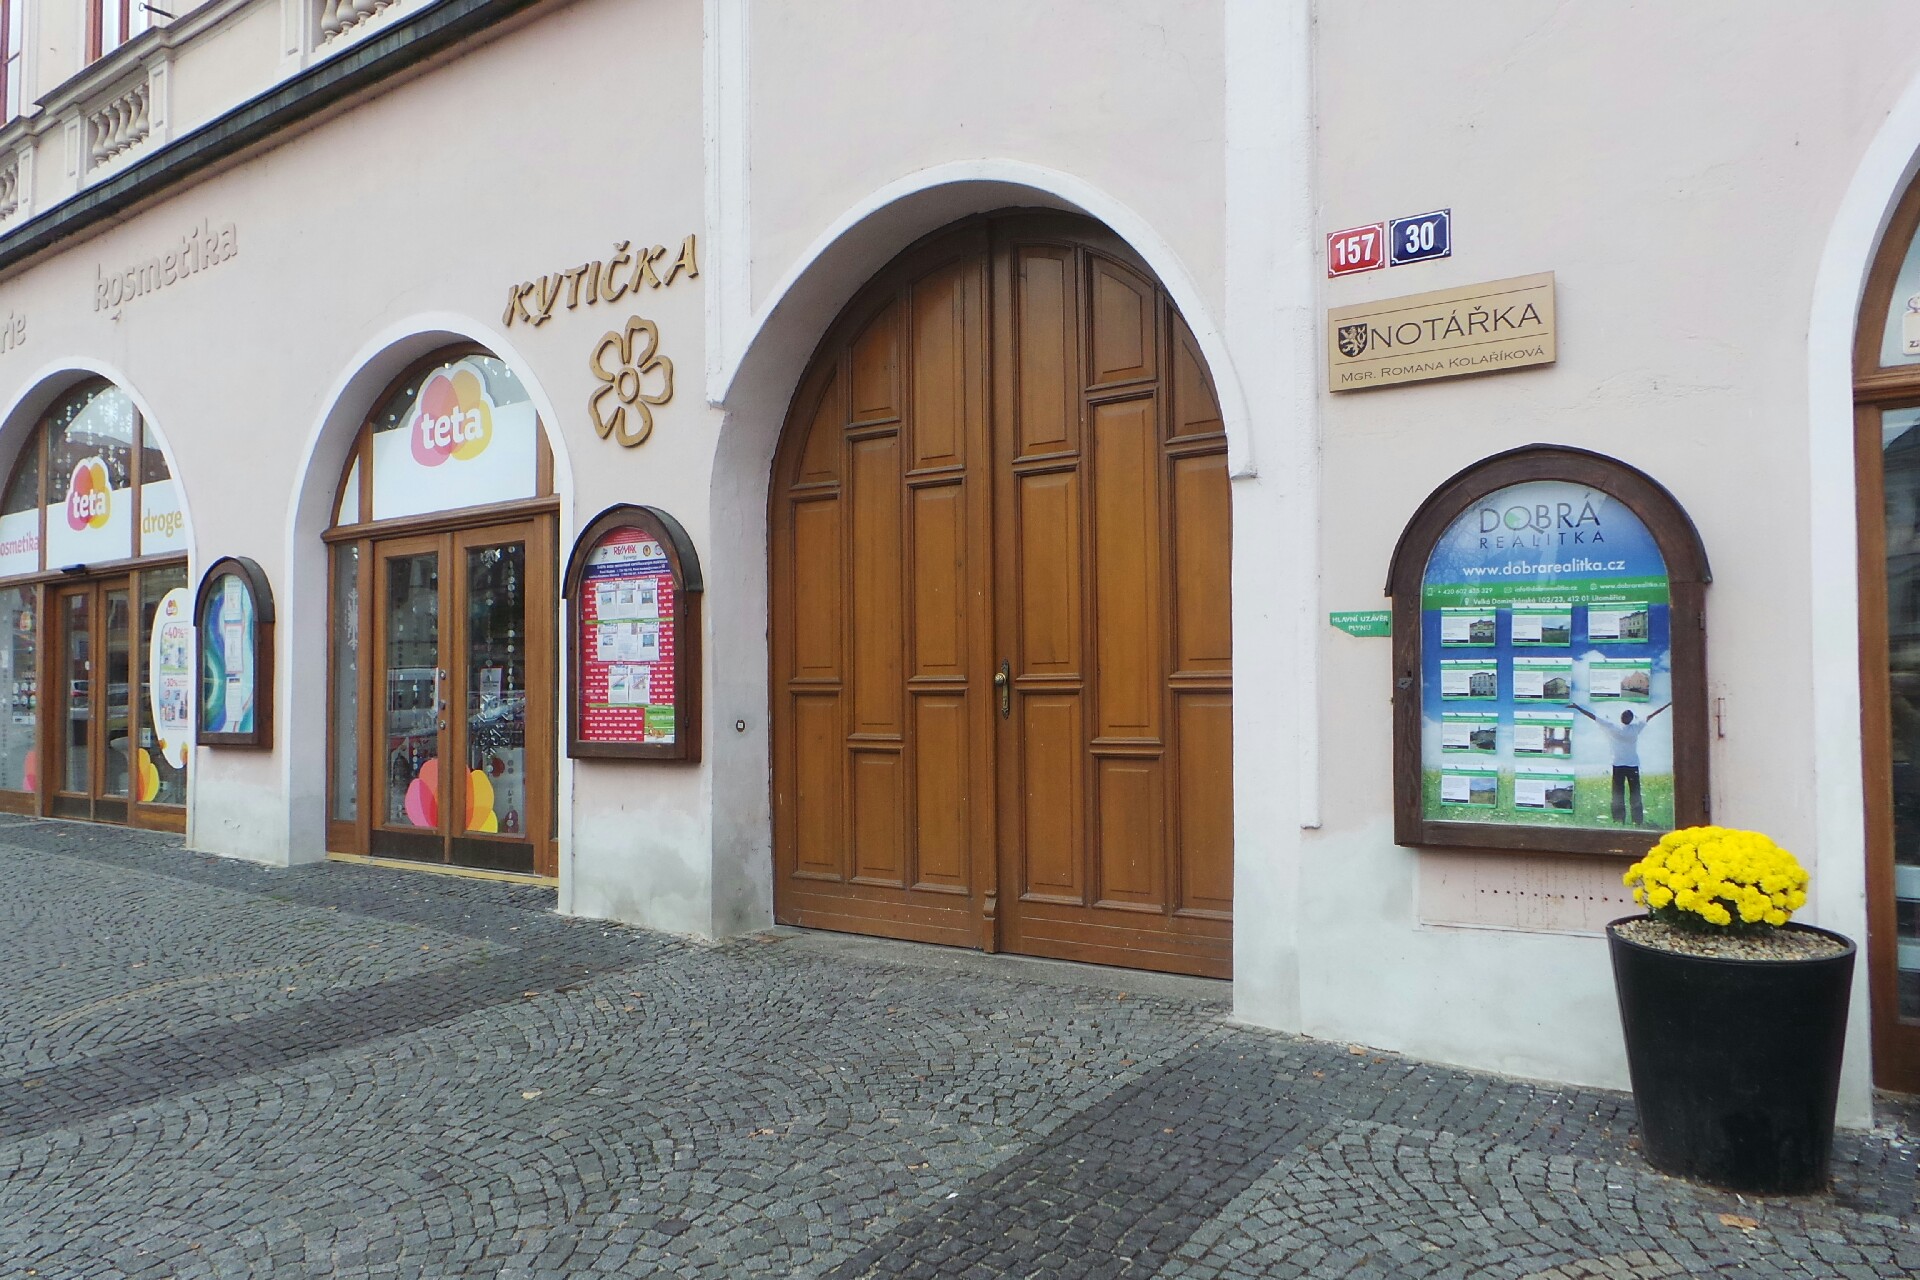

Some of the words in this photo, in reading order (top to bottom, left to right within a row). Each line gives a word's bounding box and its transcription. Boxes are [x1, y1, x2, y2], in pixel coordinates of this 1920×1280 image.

[1335, 233, 1375, 266] 157
[1405, 220, 1435, 254] 30
[93, 217, 239, 312] kosmetika
[502, 233, 699, 328] KYTIČKA
[1370, 302, 1543, 350] NOTÁŘKA
[1381, 360, 1445, 378] ROMANA
[421, 405, 484, 450] teta
[72, 489, 106, 519] teta
[1479, 492, 1601, 535] DOBRÁ
[142, 507, 185, 539] droge
[1479, 530, 1605, 549] REALITKA
[1462, 556, 1626, 577] www.dobrarealitka.cz
[1332, 614, 1359, 623] HLAVNÍ
